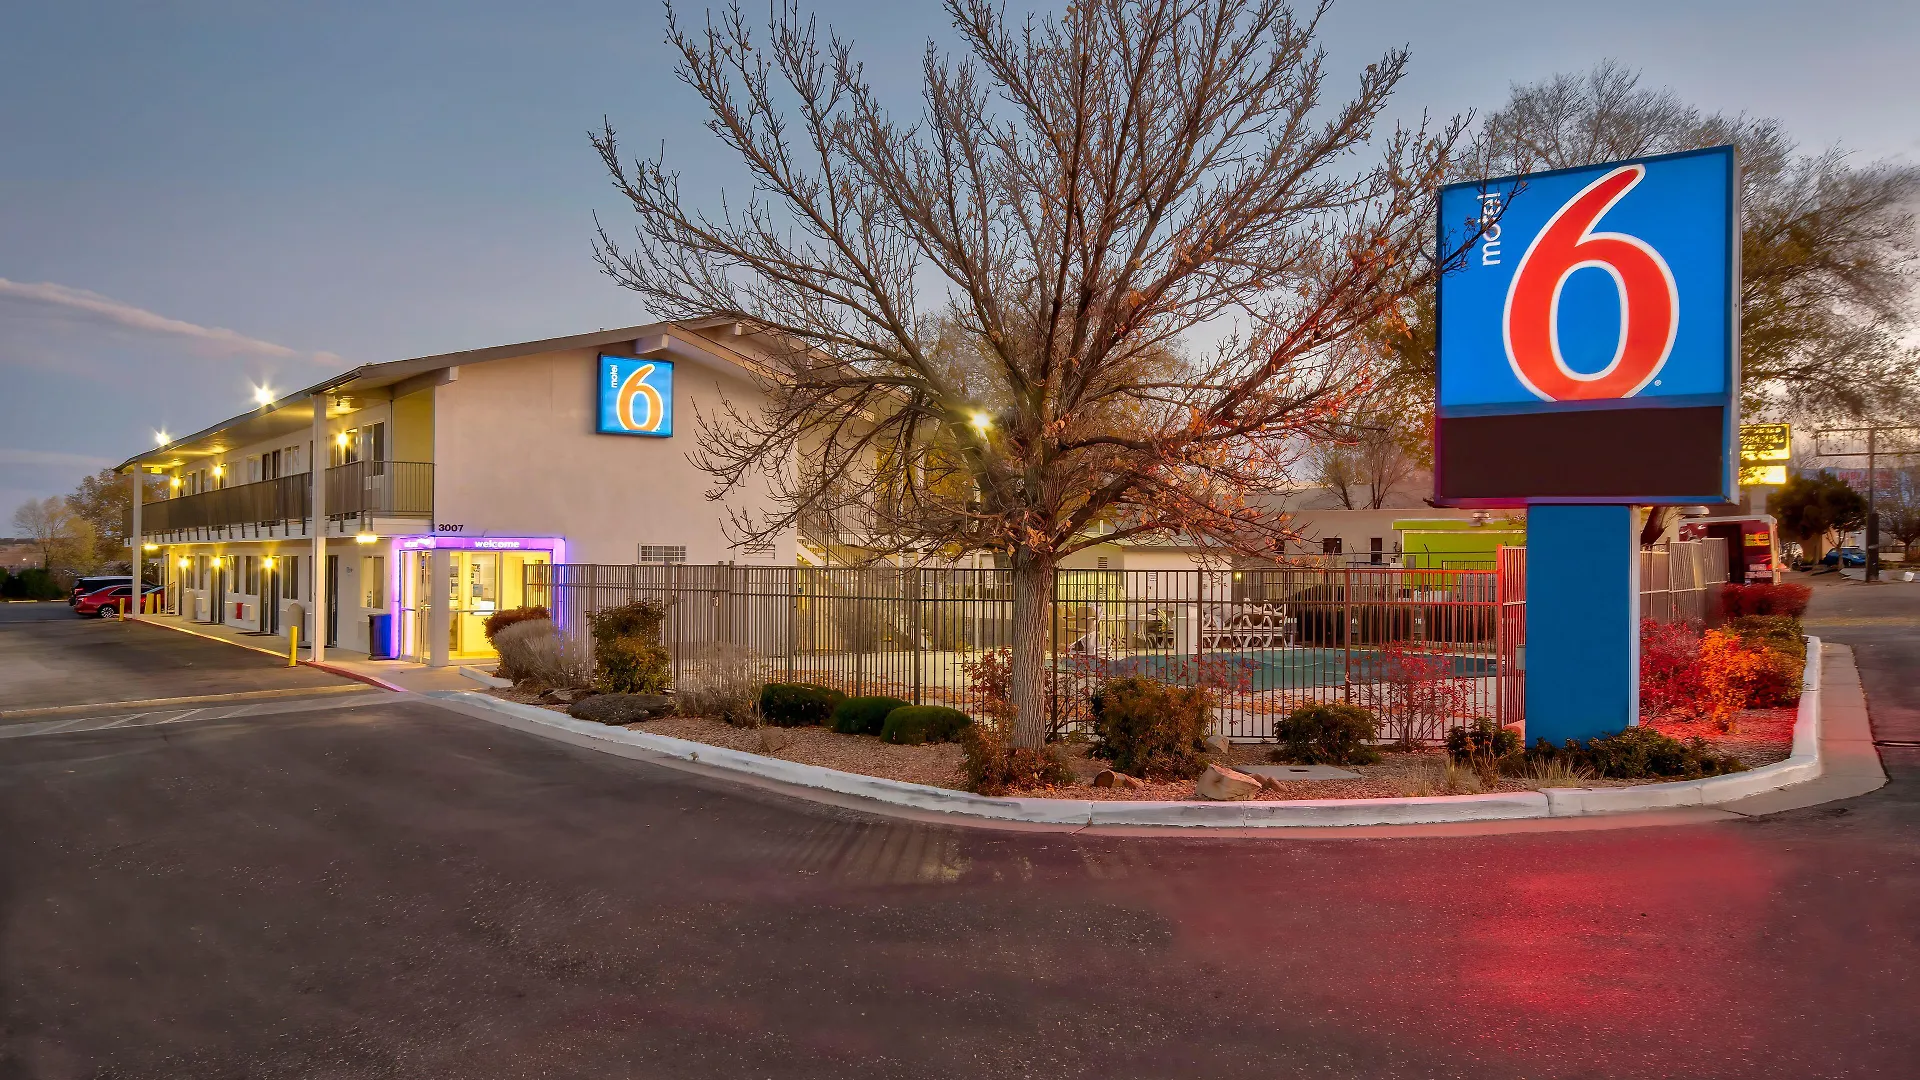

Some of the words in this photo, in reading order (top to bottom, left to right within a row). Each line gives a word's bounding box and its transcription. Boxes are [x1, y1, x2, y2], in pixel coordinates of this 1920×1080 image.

[1477, 193, 1501, 266] motel
[1502, 163, 1679, 402] 6
[609, 364, 618, 388] motel
[616, 363, 663, 432] 6
[438, 524, 464, 532] 3007
[474, 540, 520, 548] welcome
